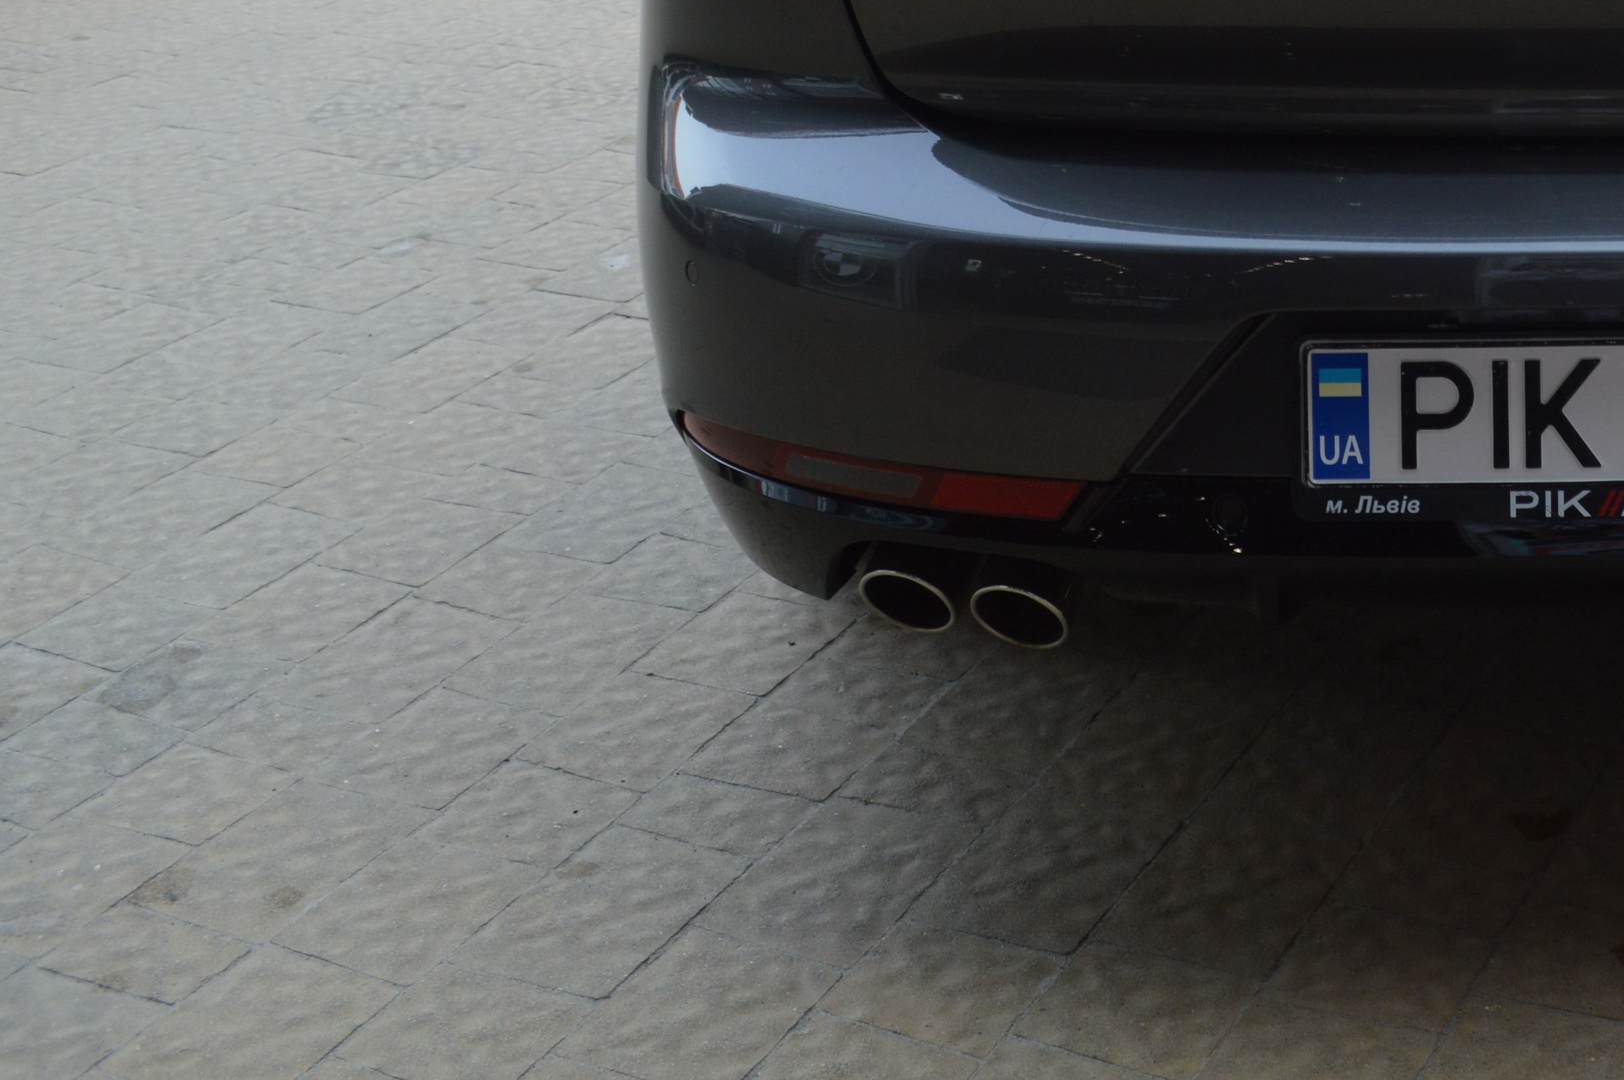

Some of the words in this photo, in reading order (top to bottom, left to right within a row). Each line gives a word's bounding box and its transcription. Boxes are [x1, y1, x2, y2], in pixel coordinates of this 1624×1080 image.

[1399, 359, 1602, 471] РІК
[1318, 434, 1364, 466] UA
[1325, 497, 1349, 514] м.
[1354, 494, 1421, 515] Львів
[1509, 489, 1593, 519] РІК
